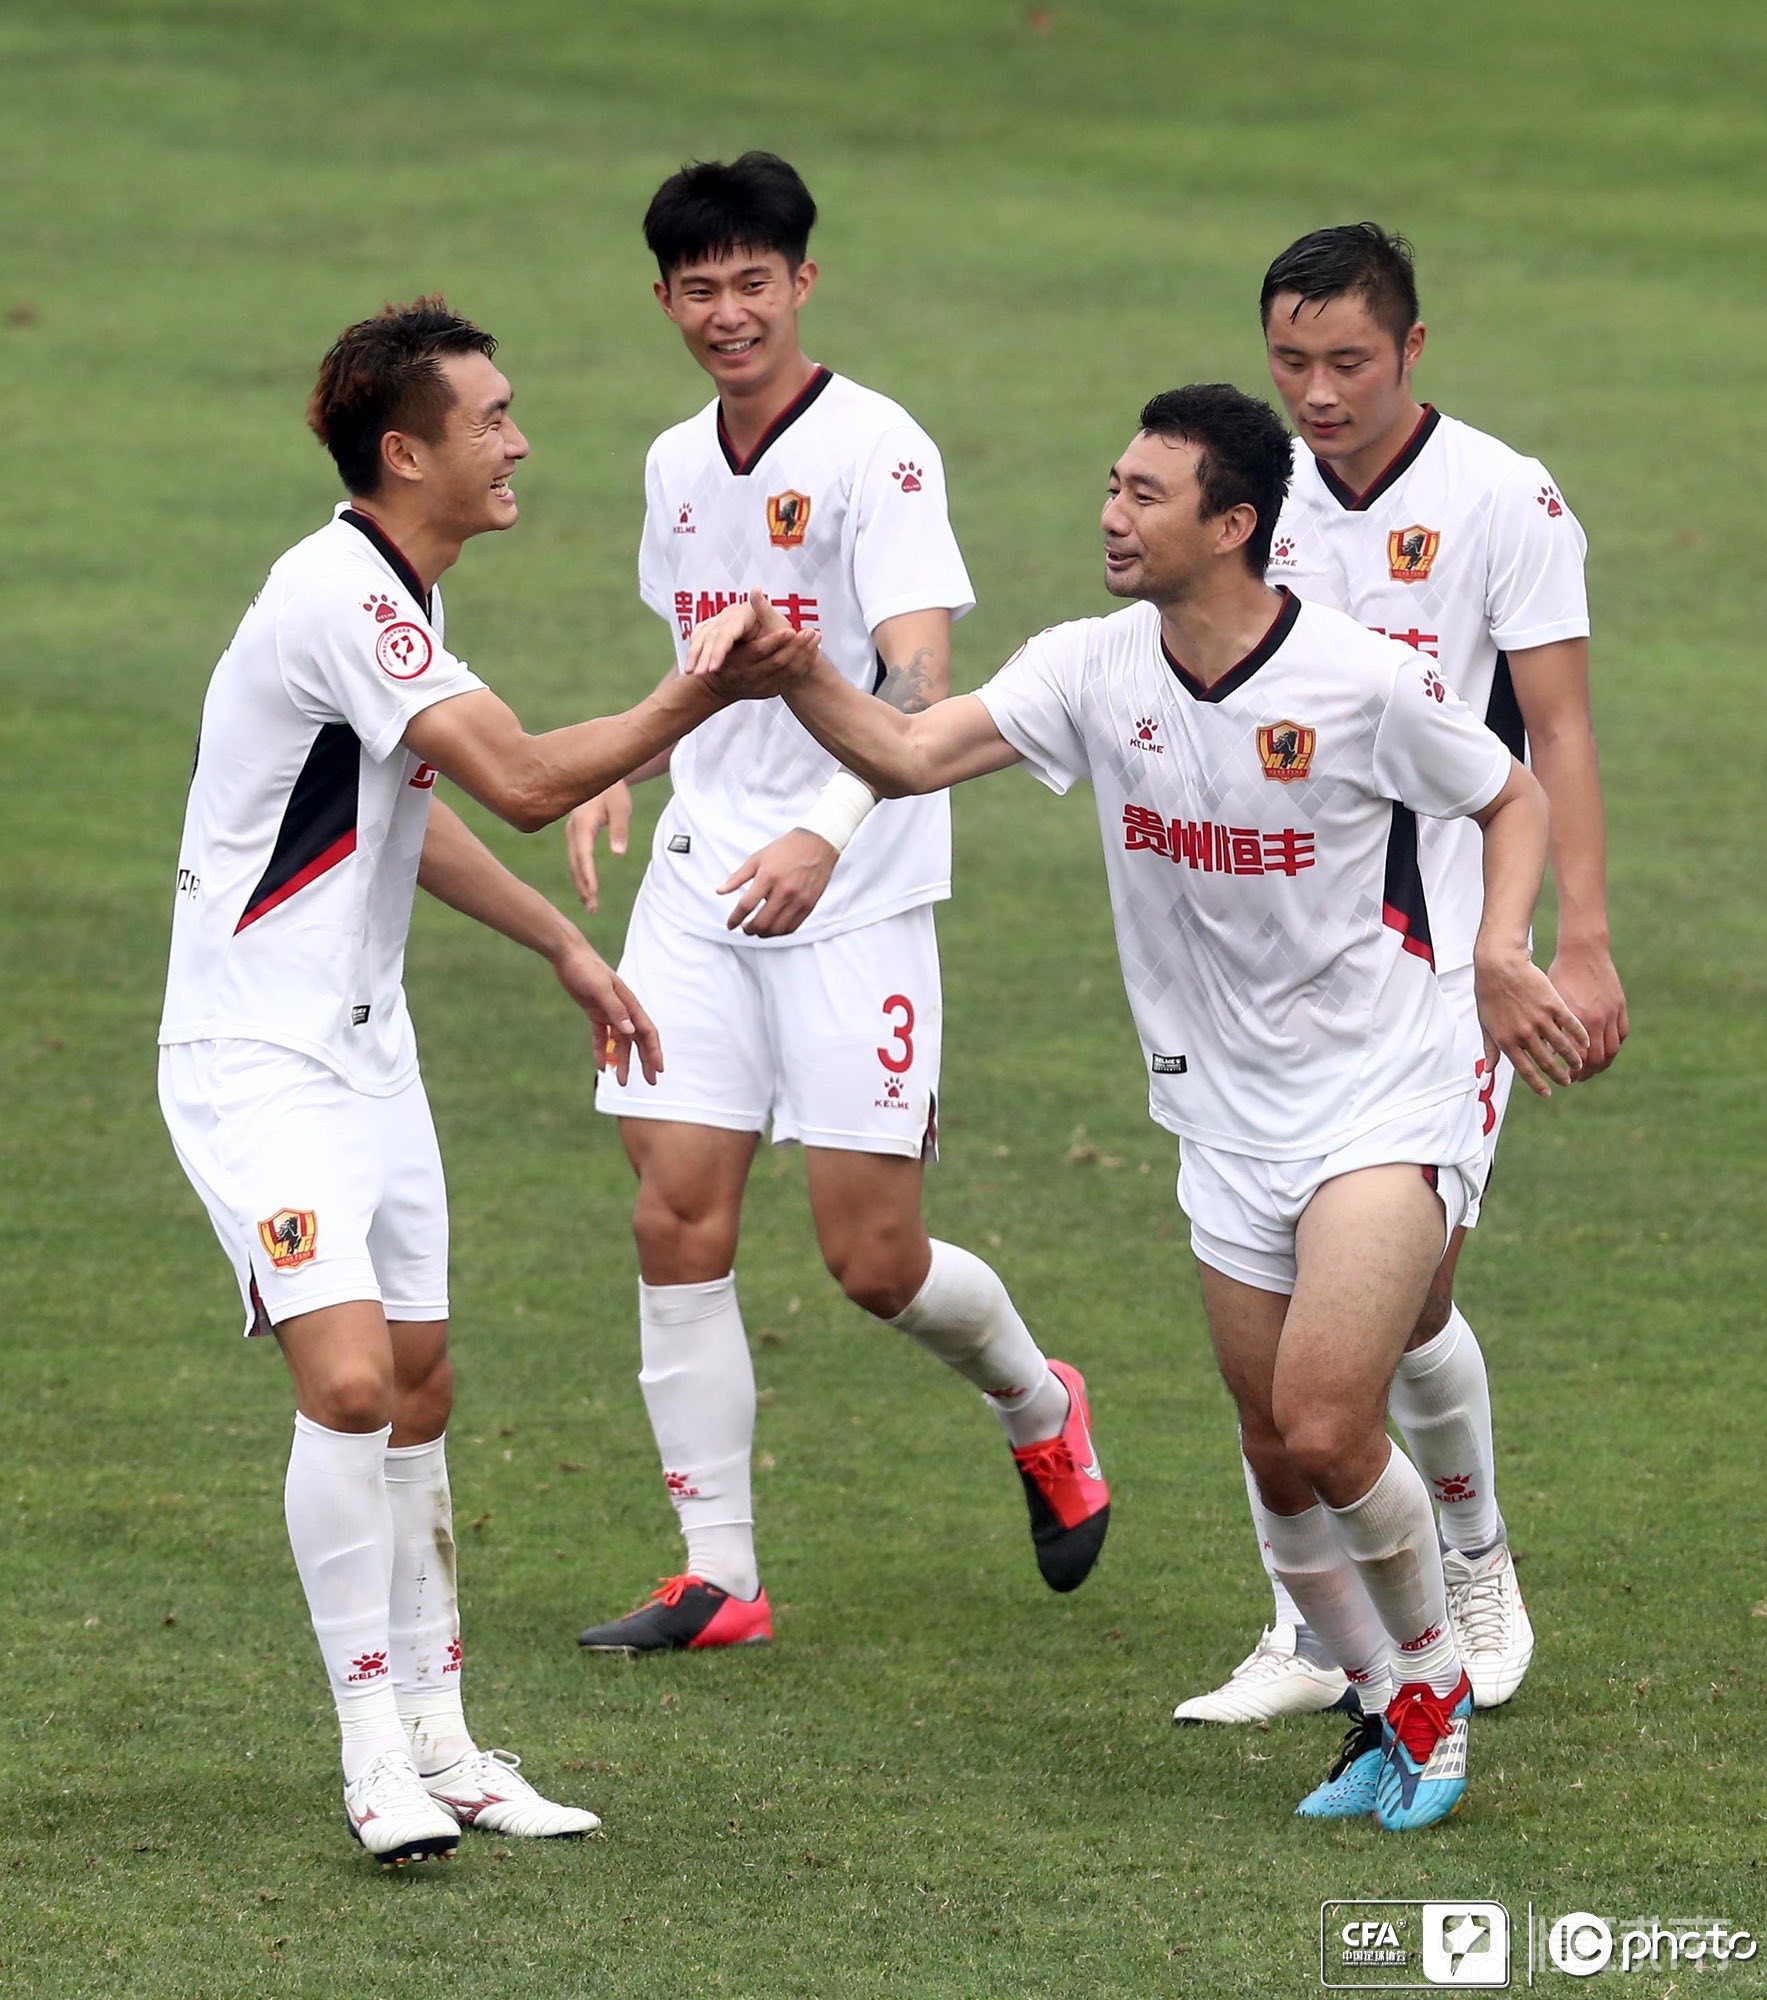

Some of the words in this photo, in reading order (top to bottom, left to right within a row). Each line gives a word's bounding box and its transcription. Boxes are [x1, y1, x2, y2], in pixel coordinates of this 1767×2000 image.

[1267, 557, 1298, 567] ELME
[1129, 738, 1165, 754] KELME
[1122, 803, 1316, 877] 贵州恒丰
[877, 993, 915, 1073] 3
[874, 1099, 910, 1110] KELME
